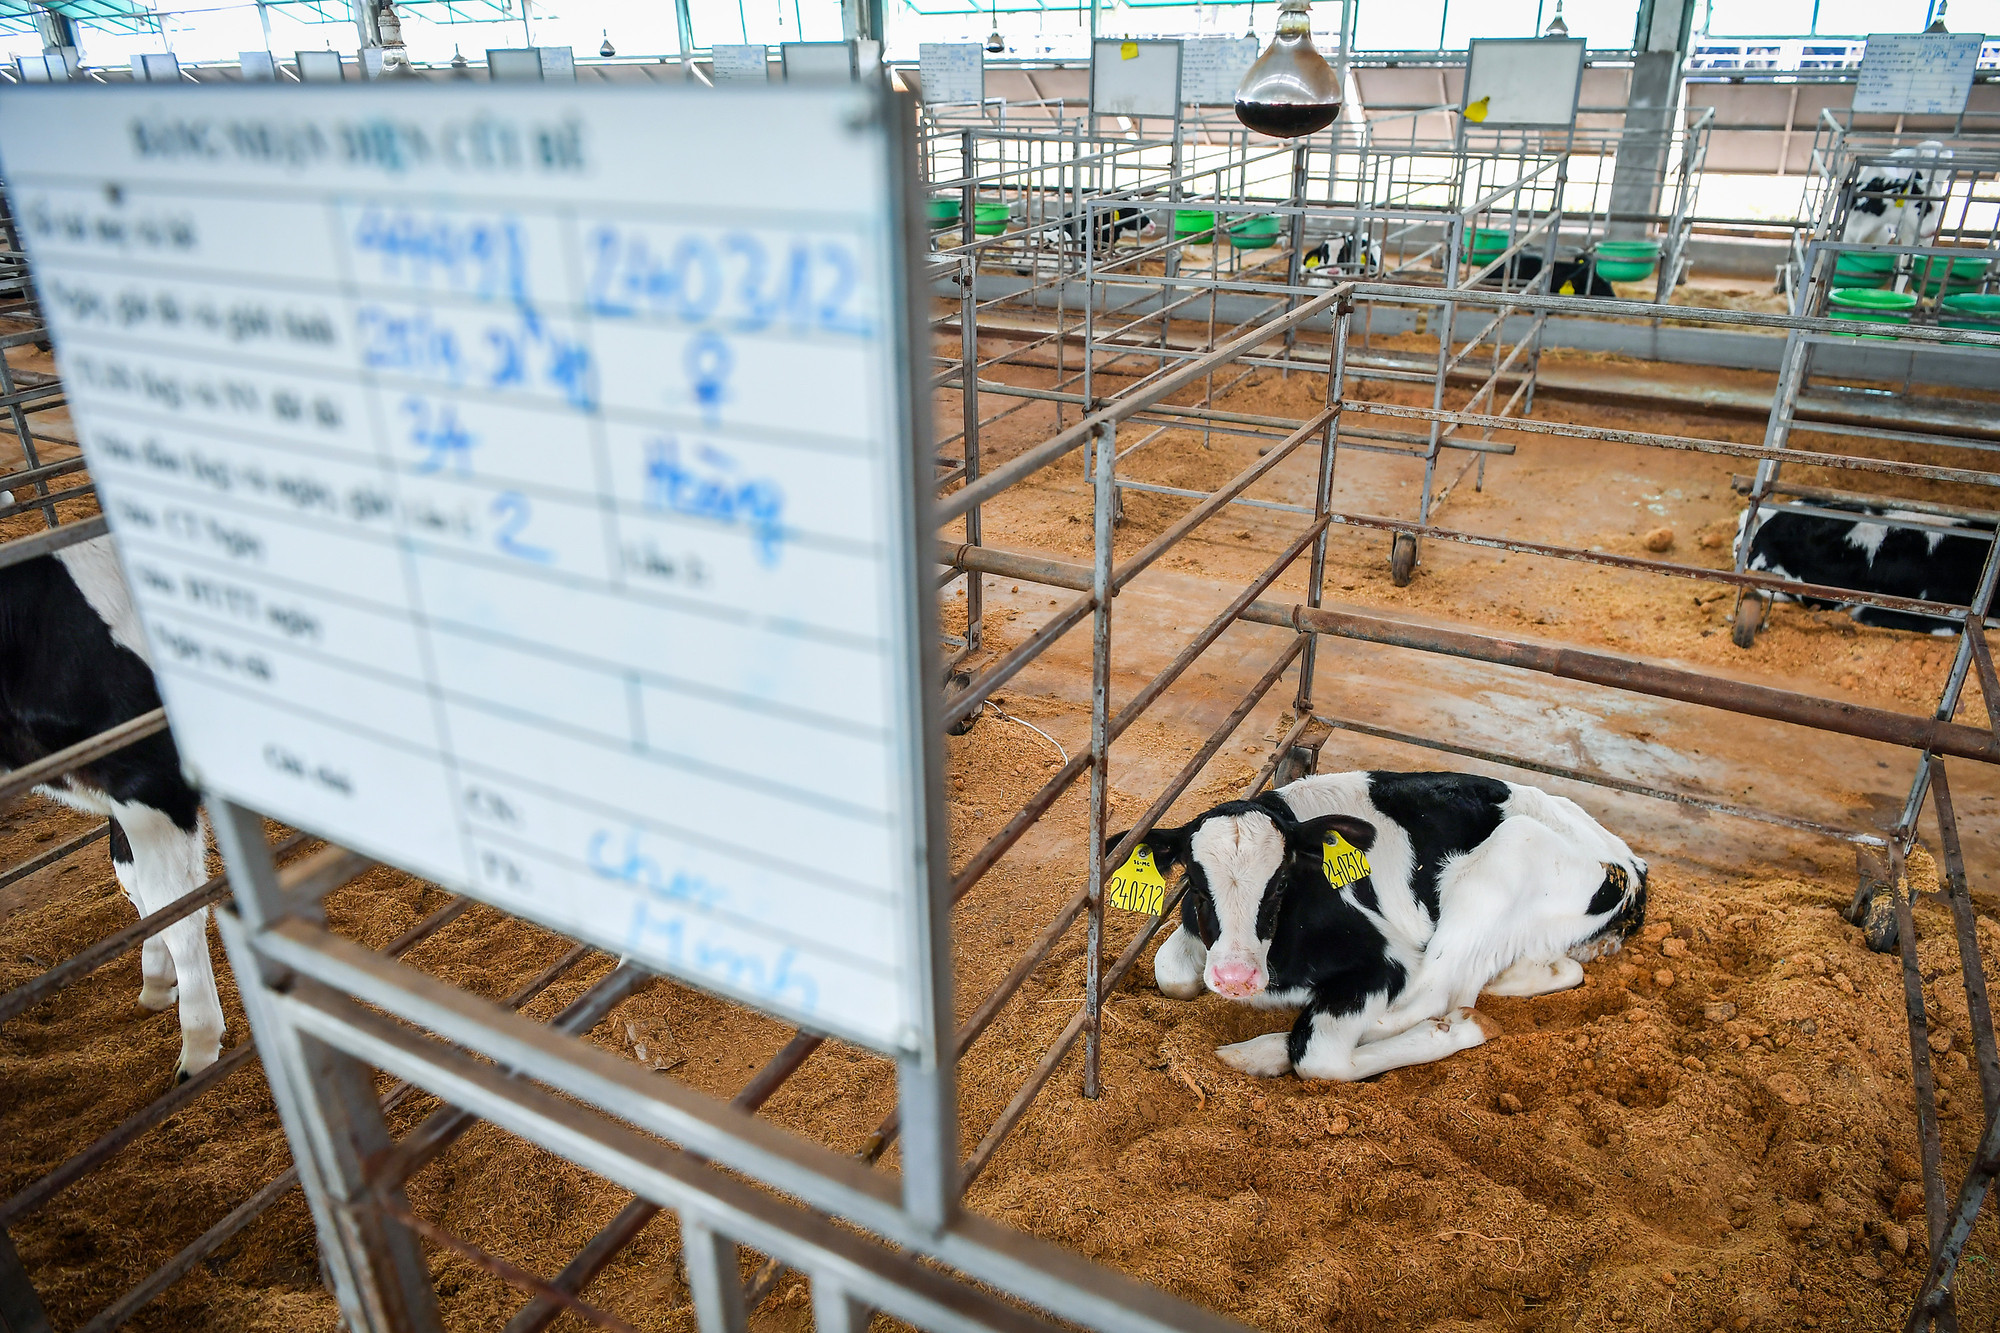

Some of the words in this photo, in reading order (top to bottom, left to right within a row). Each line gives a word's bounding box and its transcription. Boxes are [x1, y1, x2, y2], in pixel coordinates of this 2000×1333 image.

[490, 488, 558, 564] 2
[1319, 847, 1371, 889] 240312
[1109, 876, 1164, 916] 240312
